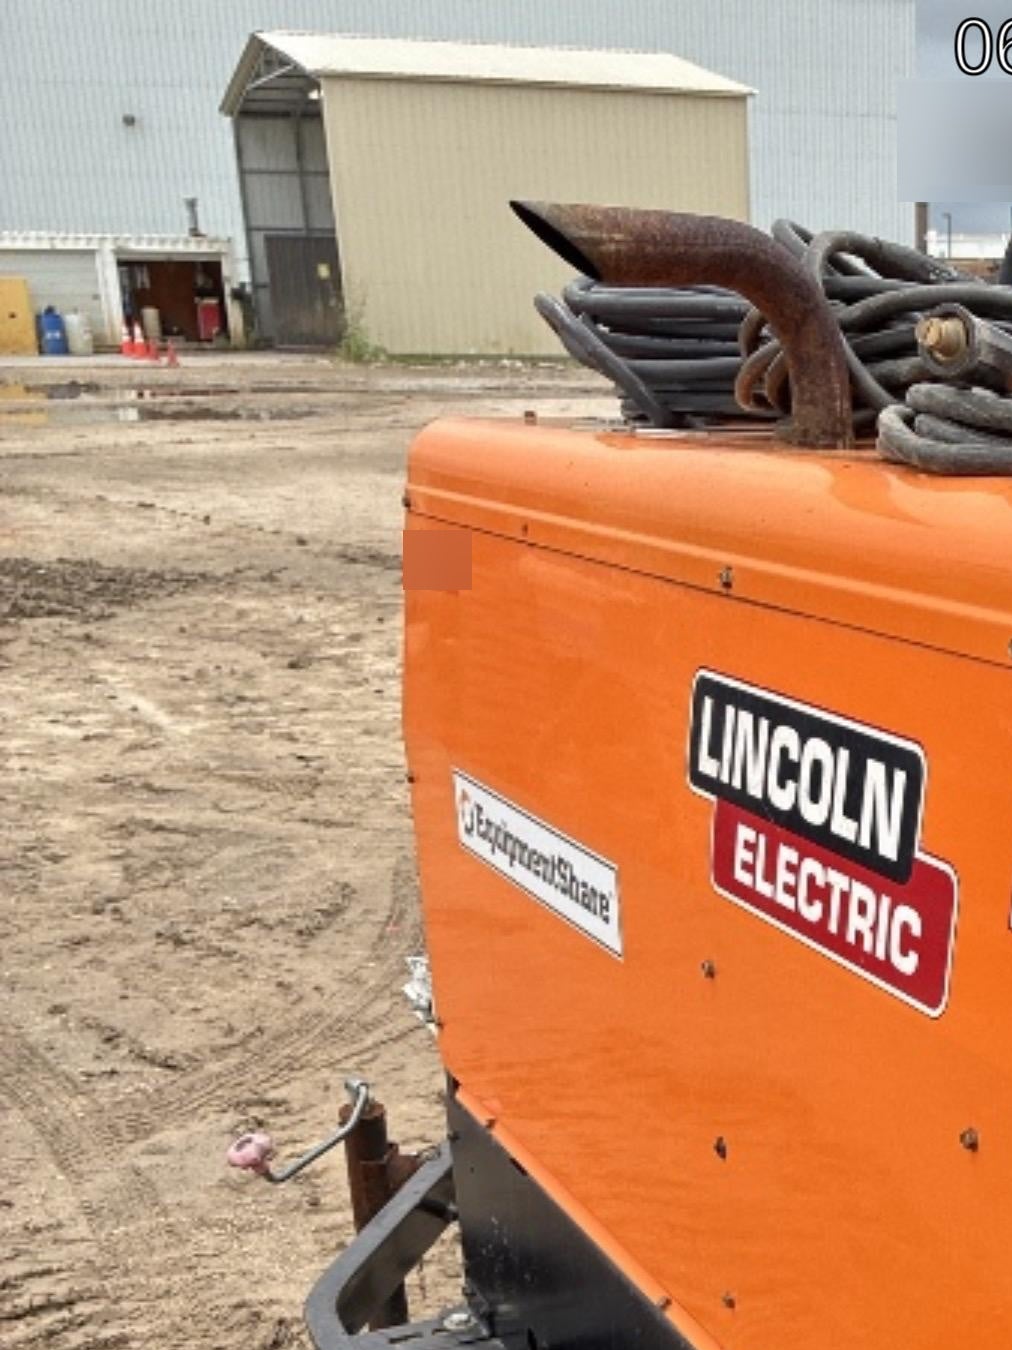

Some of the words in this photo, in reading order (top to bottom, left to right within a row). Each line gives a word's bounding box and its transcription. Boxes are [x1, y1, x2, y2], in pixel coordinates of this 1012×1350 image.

[698, 696, 907, 862] LINCOLN
[474, 803, 611, 925] EquipmentShare
[733, 823, 923, 976] ELECTRIC
